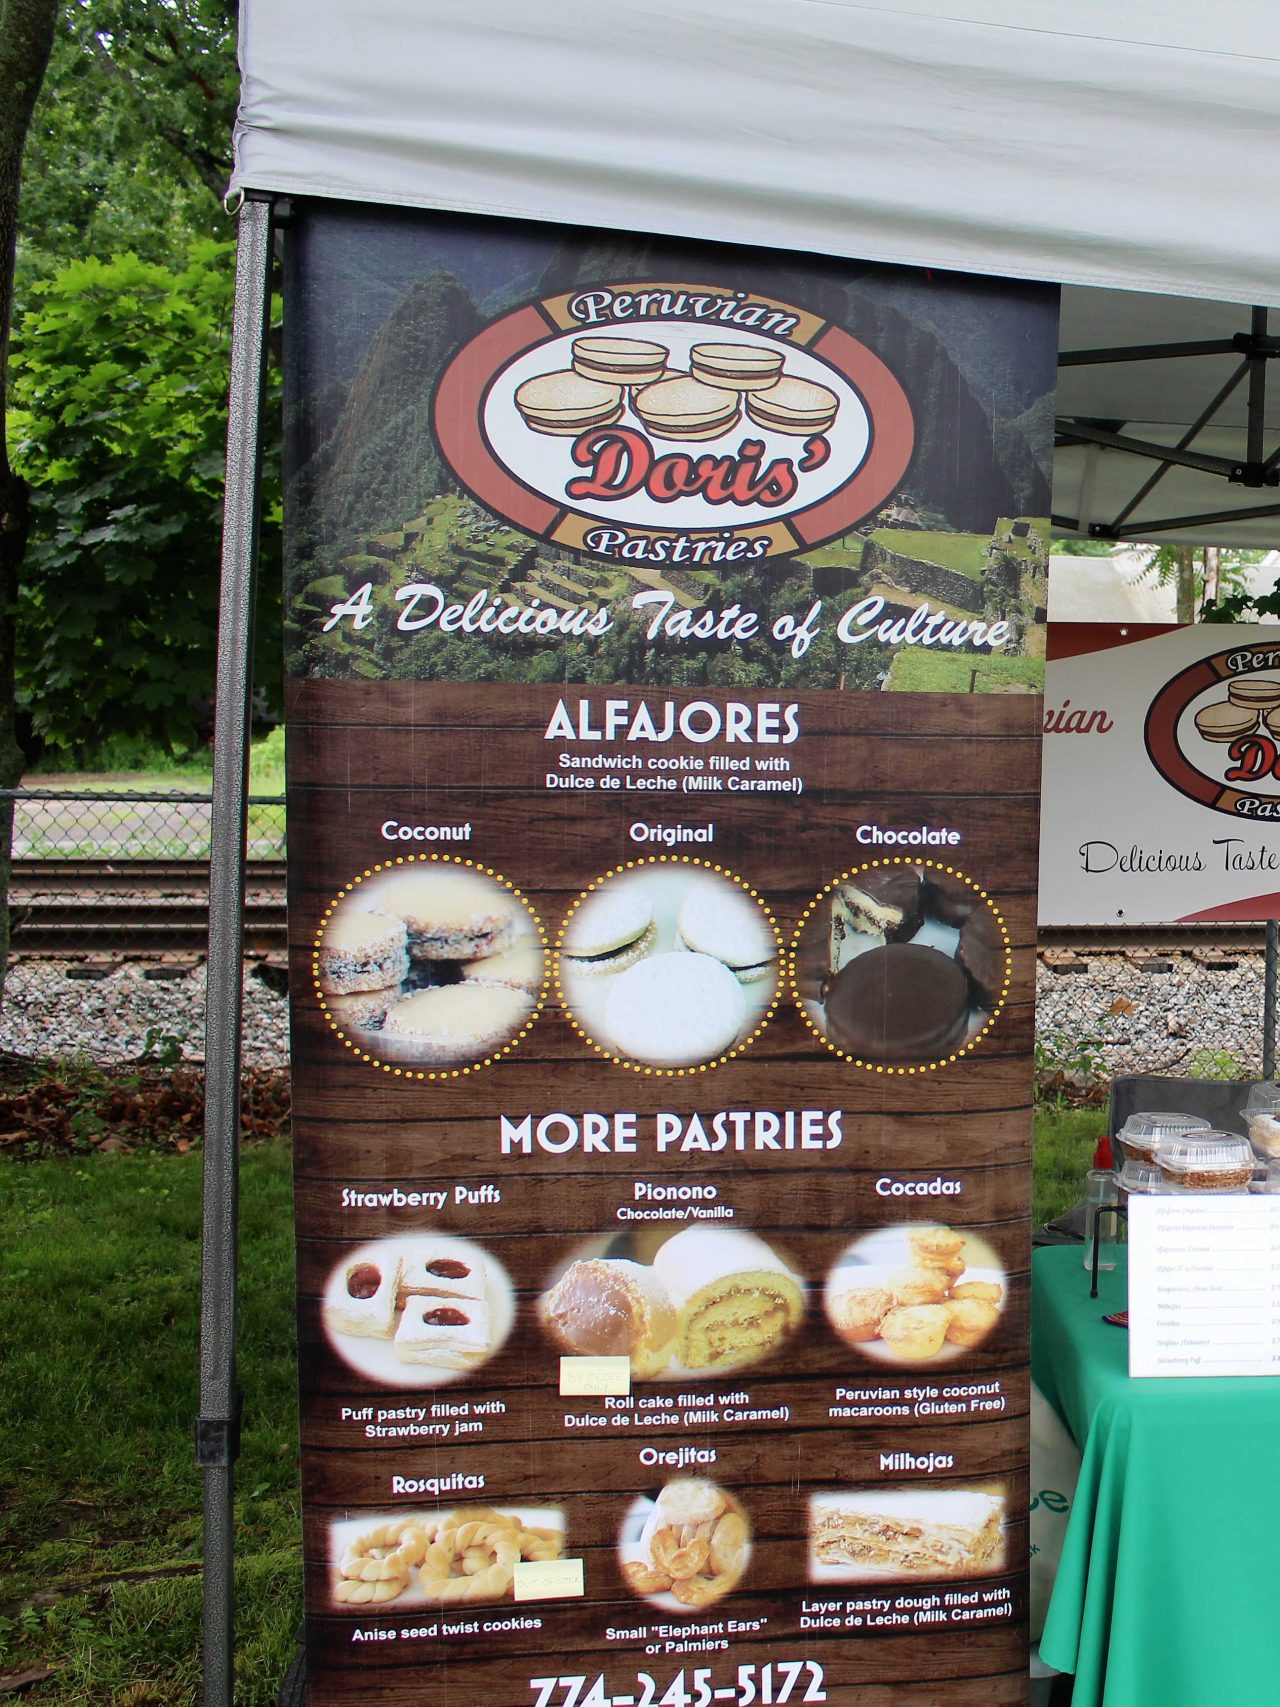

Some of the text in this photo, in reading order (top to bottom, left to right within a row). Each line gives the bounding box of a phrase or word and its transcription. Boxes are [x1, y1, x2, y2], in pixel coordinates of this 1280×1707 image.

[571, 289, 799, 336] Peruvian
[566, 426, 830, 503] Doris'
[586, 529, 770, 562] Pastries
[324, 582, 1010, 660] A Delicious Taste of Culture
[544, 699, 798, 743] ALFAJORES
[559, 754, 789, 770] Sandwich cookie filled with
[546, 774, 802, 794] Dulce de Leche (Milk Caramel)
[382, 821, 471, 840] Coconut
[630, 823, 712, 846] Original
[856, 826, 960, 844] Chocolate
[1079, 841, 1206, 874] Delicious
[1213, 838, 1280, 871] Taste
[501, 1111, 842, 1153] MORE PASTRIES
[342, 1185, 500, 1209] Strawberry Puffs
[635, 1183, 716, 1200] Pionono
[876, 1177, 961, 1195] Cocadas
[617, 1206, 733, 1224] Chocolate/Vanilla
[604, 1392, 749, 1409] Roll cake filled with
[835, 1382, 1000, 1402] Peruvian style coconut
[342, 1401, 506, 1423] Puff pastry filled with
[565, 1407, 789, 1426] Dulce de Leche (Milk Caramel)
[829, 1397, 1006, 1417] macaroons (Gluten Free)
[366, 1421, 483, 1439] Strawberry jam
[640, 1447, 716, 1468] Orejitas
[880, 1453, 953, 1472] Milhojas
[393, 1473, 484, 1495] Rosquitas
[801, 1588, 1010, 1616] Layer pastry dough filled with
[801, 1602, 1013, 1629] Dulce de Leche (Milk Caramel)
[353, 1616, 542, 1641] Anise seed twist cookies
[606, 1617, 768, 1640] Small "Elephant Ears"
[646, 1635, 729, 1654] or Palmiers
[530, 1661, 826, 1707] 774-245-5172
